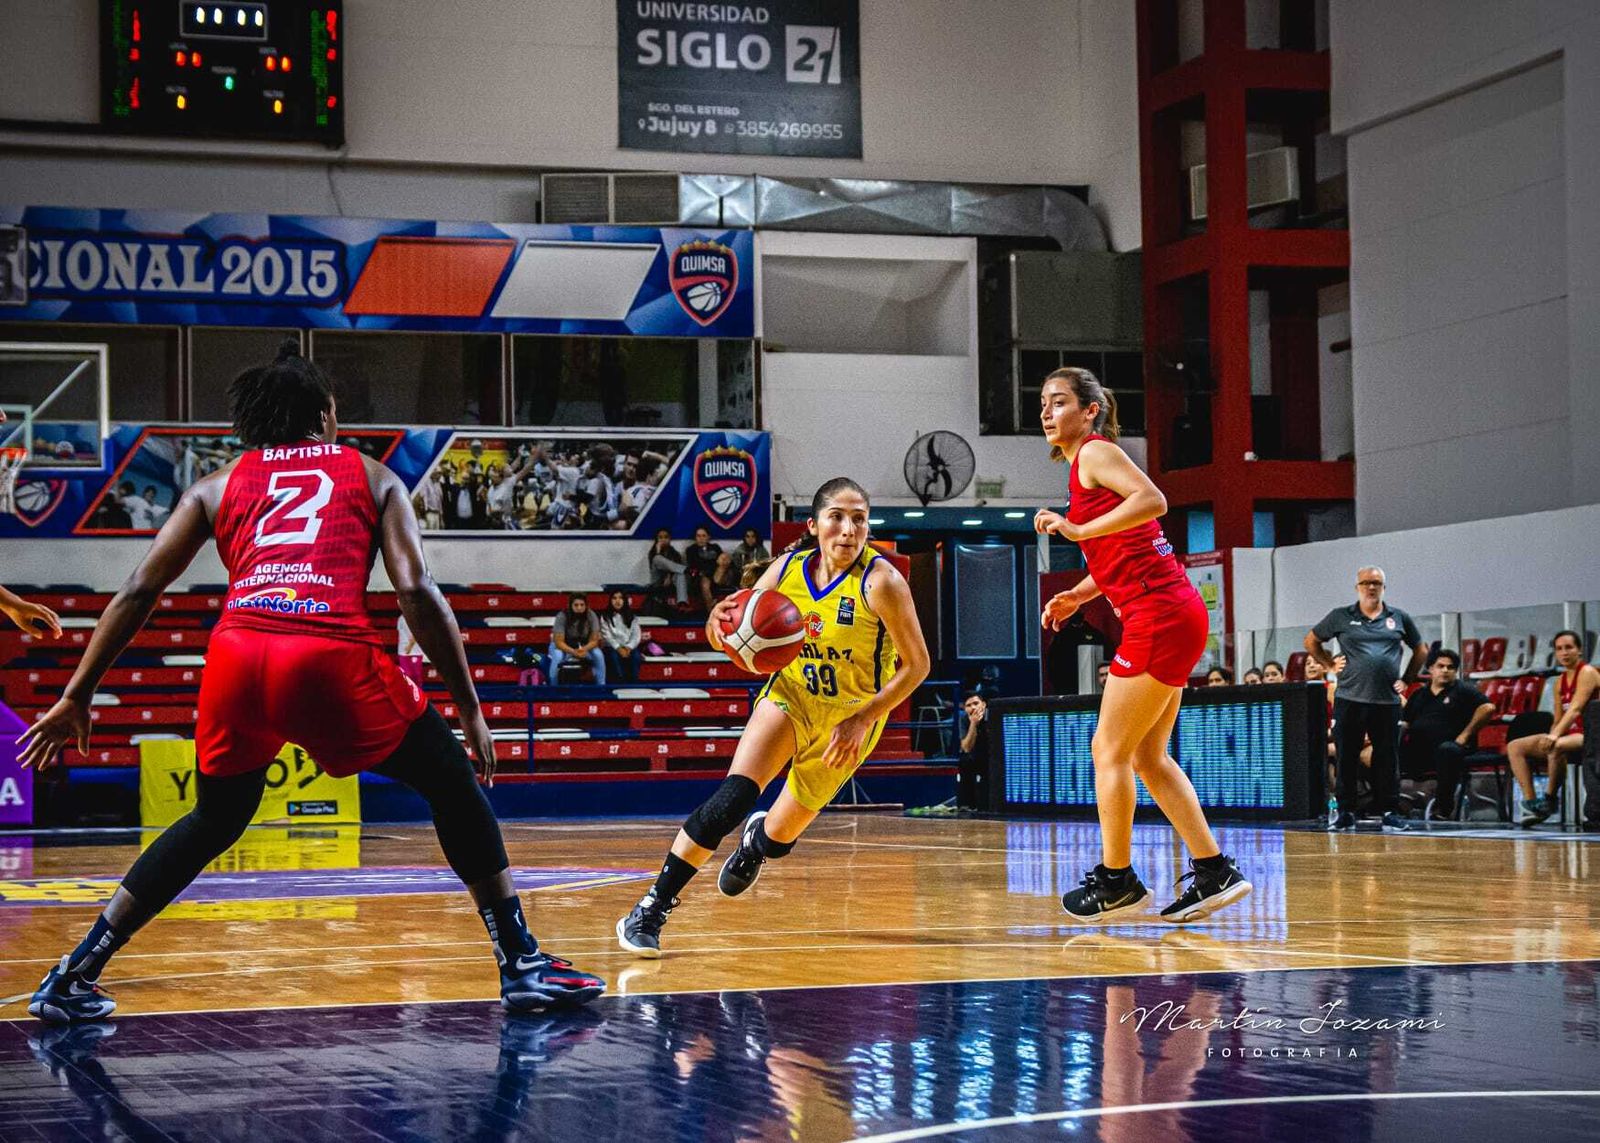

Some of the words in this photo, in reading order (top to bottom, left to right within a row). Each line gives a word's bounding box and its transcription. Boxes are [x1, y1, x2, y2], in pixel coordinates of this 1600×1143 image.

[637, 0, 769, 23] UNIVERSIDAD
[636, 28, 772, 71] SIGLO
[790, 26, 840, 84] 21
[647, 116, 701, 138] Jujuy
[704, 119, 717, 134] 8
[736, 120, 843, 139] 3854269955
[221, 246, 338, 298] 2015
[681, 255, 726, 273] QUIMSA
[262, 444, 342, 462] BAPTISTE
[704, 461, 745, 478] QUIMSA
[254, 468, 335, 548] 2
[254, 563, 313, 574] AGENCIA
